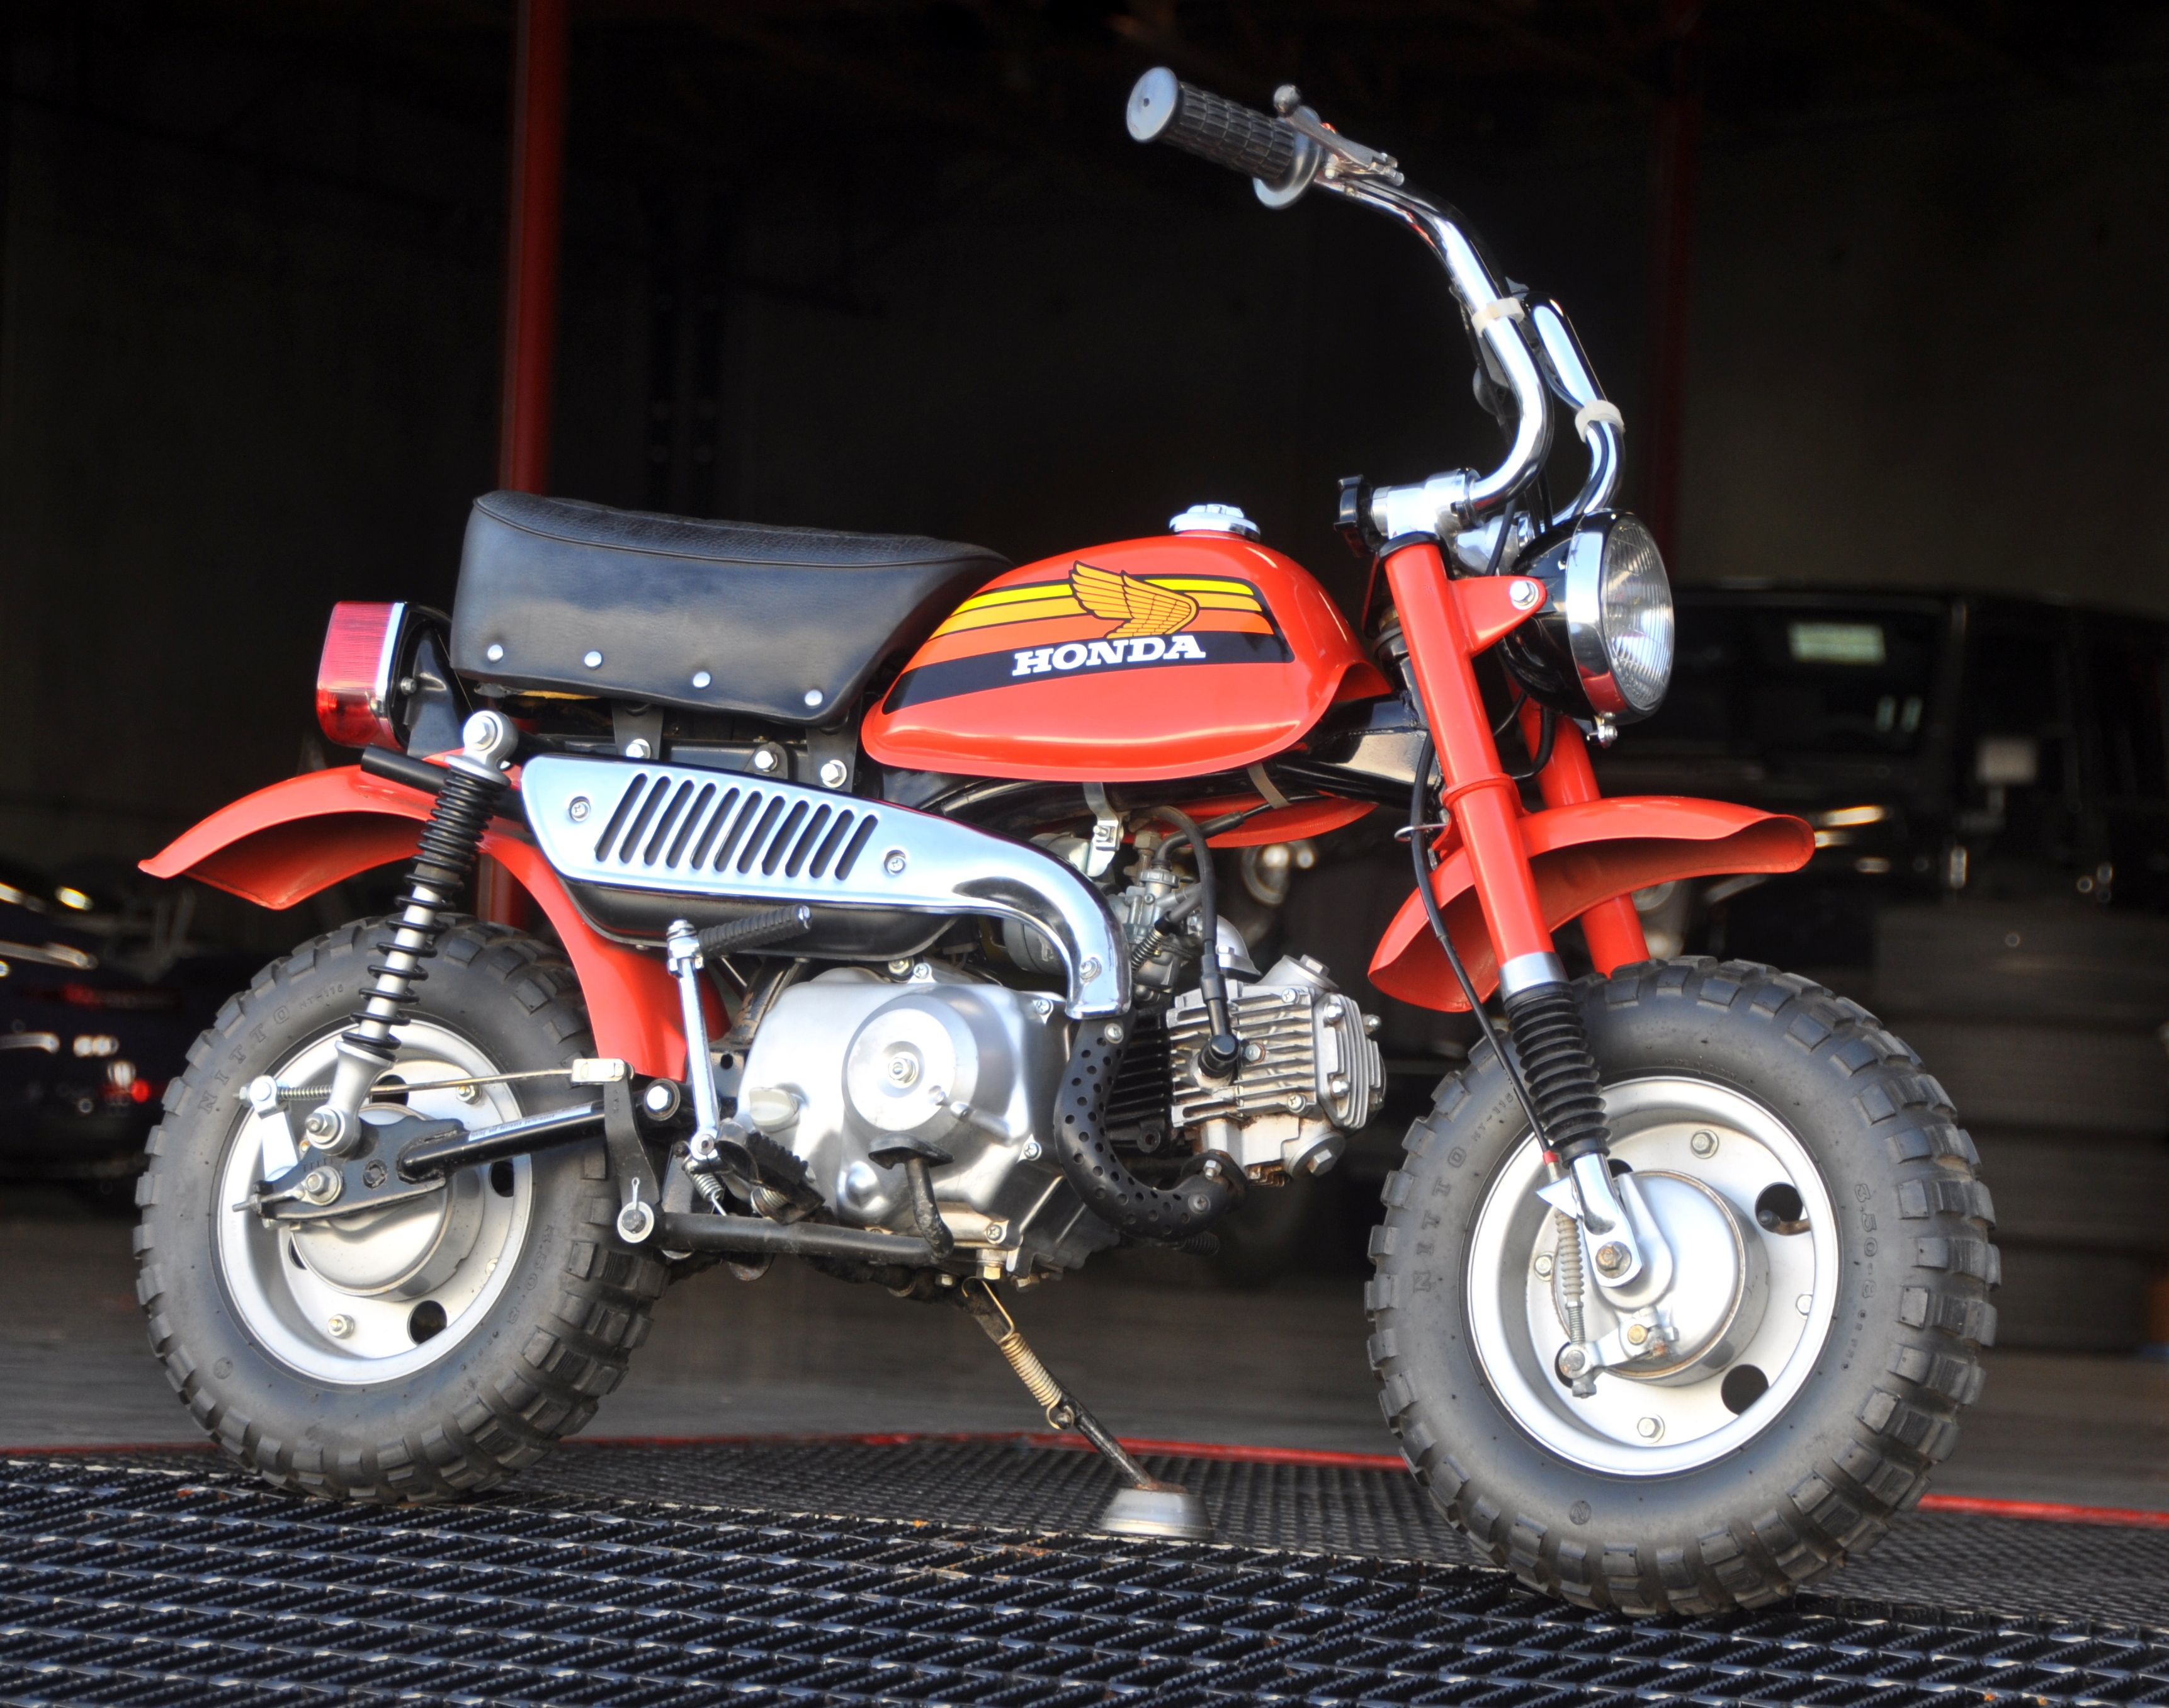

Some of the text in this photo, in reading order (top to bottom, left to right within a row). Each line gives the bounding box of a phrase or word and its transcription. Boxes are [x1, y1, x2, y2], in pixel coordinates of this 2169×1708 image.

[1012, 635, 1206, 676] HONDA
[198, 1005, 290, 1114] NITTO
[1413, 1146, 1466, 1292] NITTO
